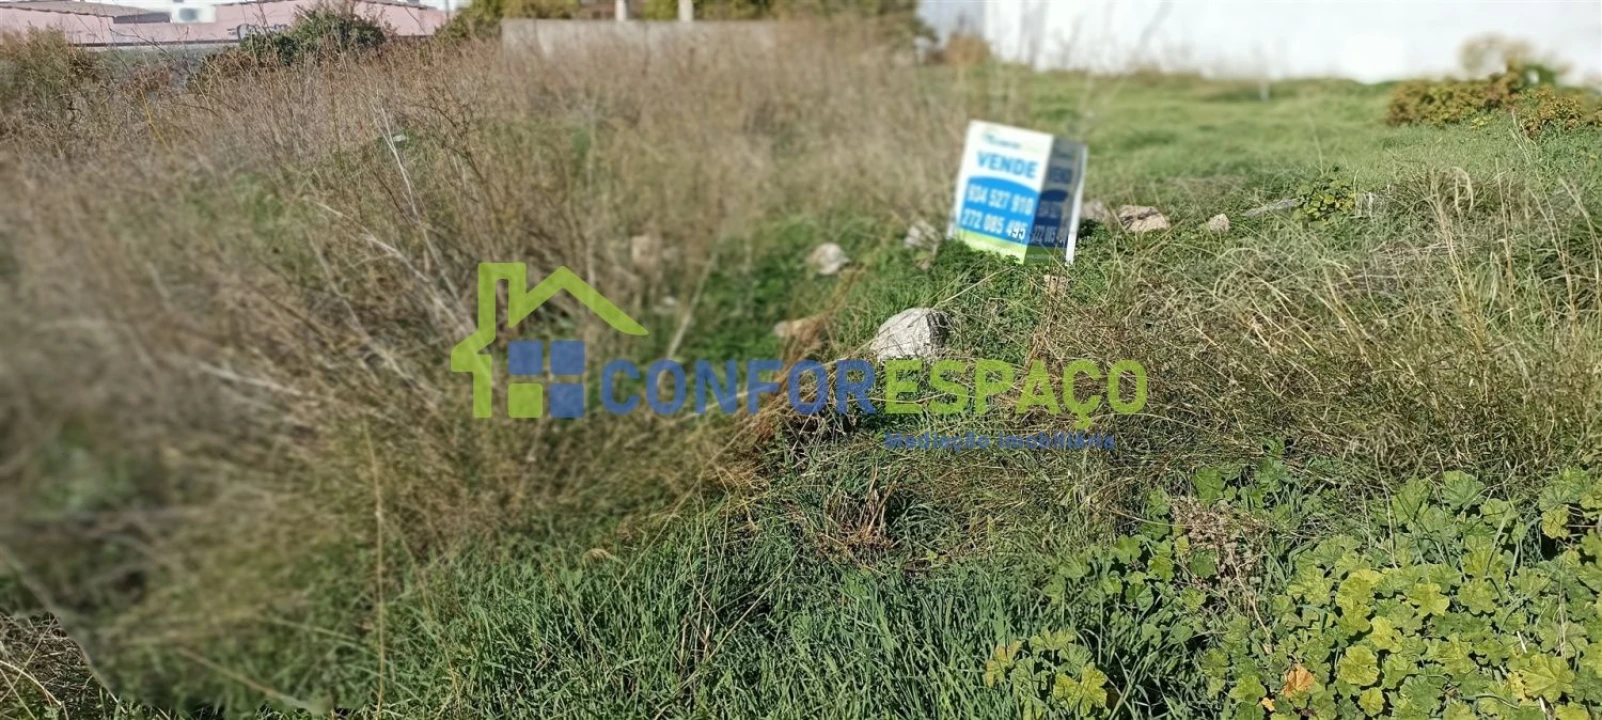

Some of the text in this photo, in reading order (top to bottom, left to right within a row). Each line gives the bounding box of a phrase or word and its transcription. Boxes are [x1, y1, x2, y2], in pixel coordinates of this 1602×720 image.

[977, 151, 1039, 179] VENDE
[988, 190, 1011, 209] 527
[961, 208, 983, 230] 272
[1005, 219, 1028, 240] 495
